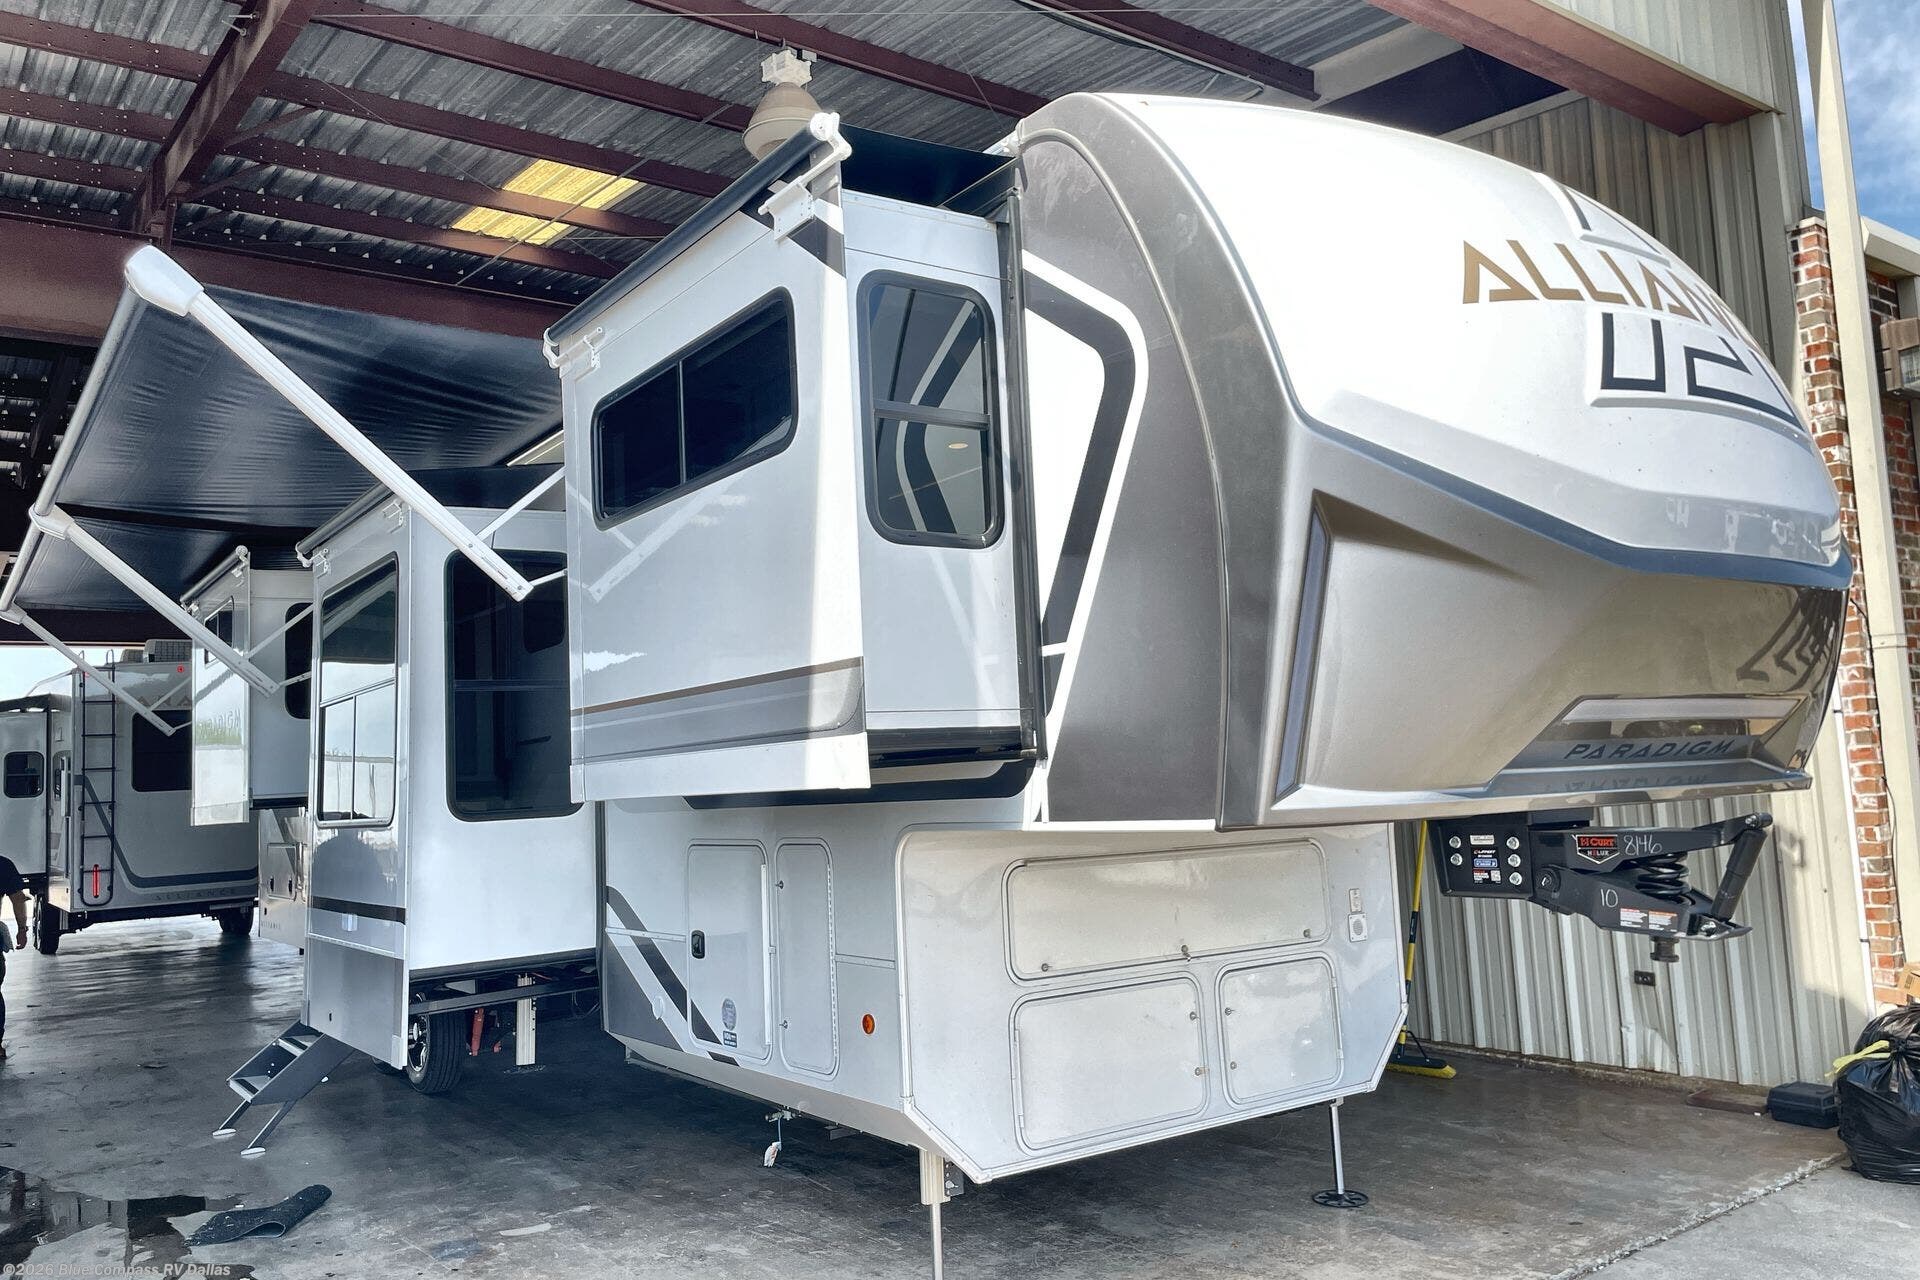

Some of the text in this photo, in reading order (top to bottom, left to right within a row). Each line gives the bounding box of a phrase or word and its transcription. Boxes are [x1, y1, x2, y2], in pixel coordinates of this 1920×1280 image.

[1463, 240, 1760, 354] ALLIAN
[1564, 738, 1736, 760] PARADIGM
[1601, 888, 1619, 908] 10
